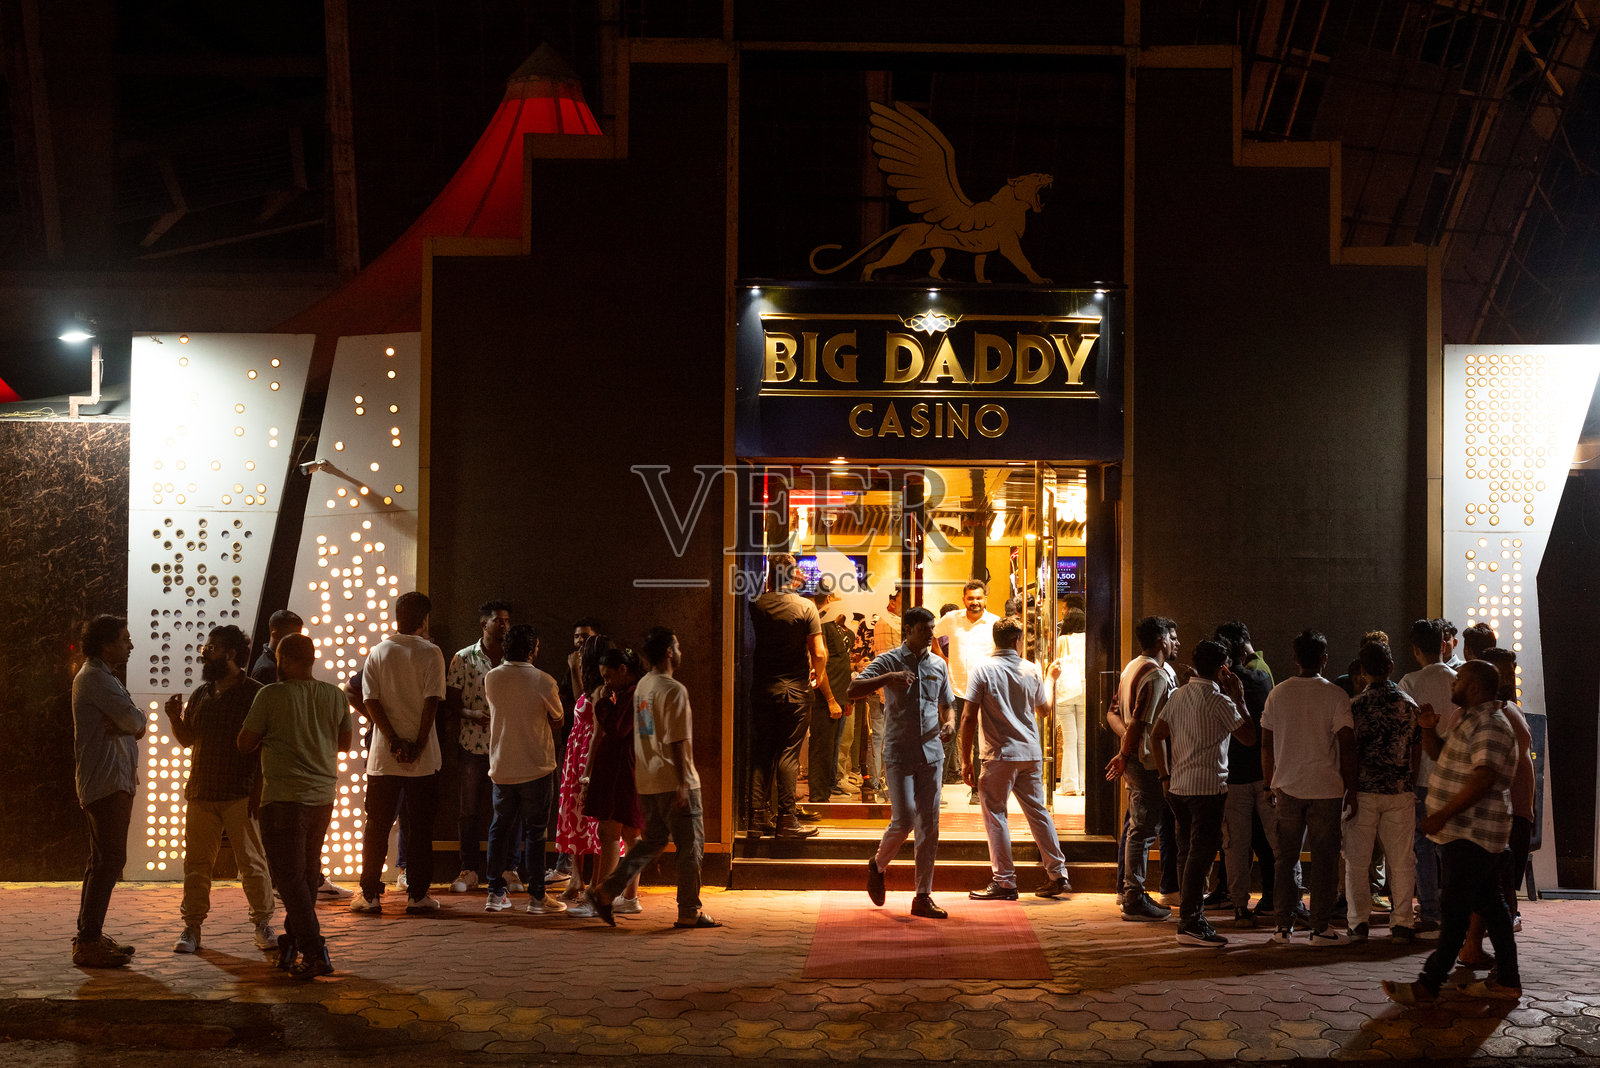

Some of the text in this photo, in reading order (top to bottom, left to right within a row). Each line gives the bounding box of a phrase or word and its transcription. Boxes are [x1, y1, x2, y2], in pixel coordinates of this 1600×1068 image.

[761, 329, 1100, 385] BIG DADDY
[848, 401, 1009, 440] CASINO
